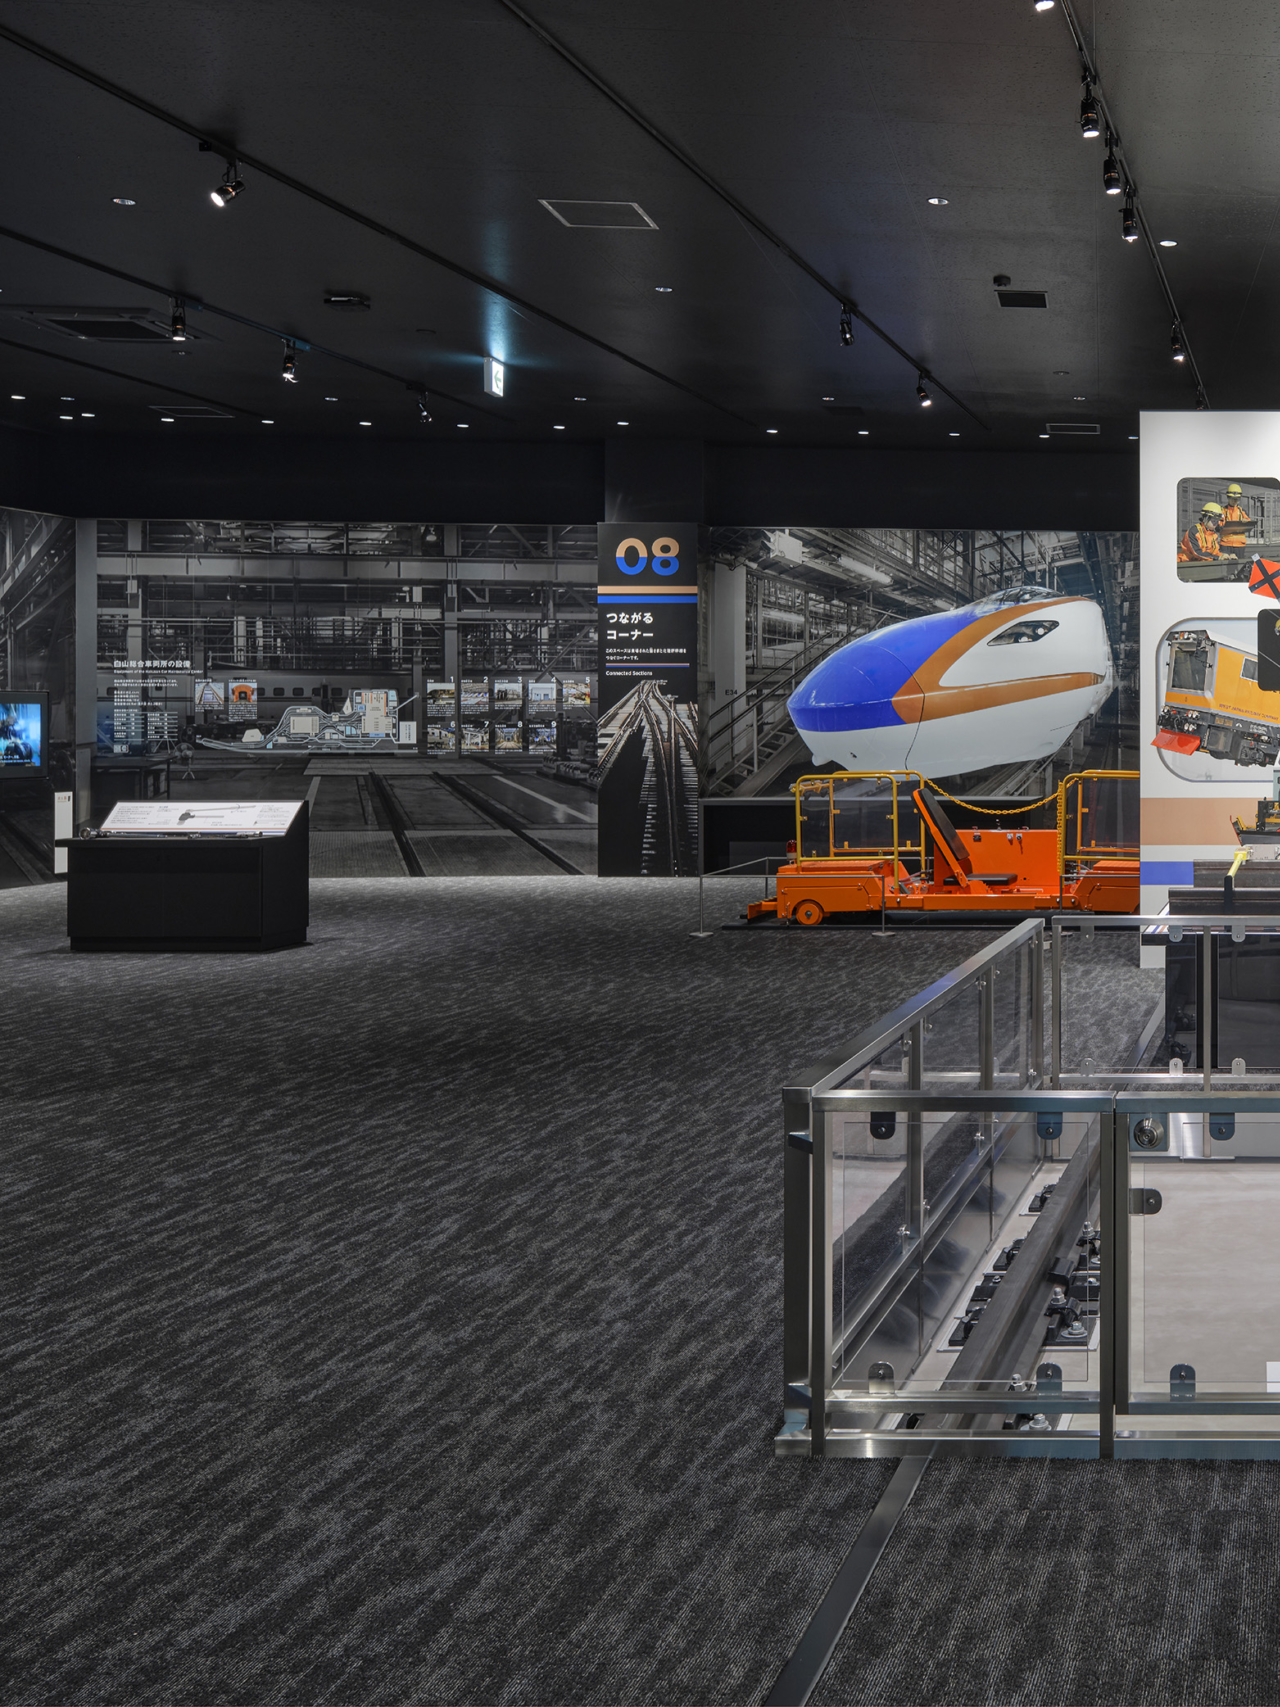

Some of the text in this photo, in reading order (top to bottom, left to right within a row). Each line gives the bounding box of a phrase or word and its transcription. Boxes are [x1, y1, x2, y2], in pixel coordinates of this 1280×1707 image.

[615, 537, 680, 576] 08
[606, 612, 654, 624] つながる
[606, 629, 654, 641] コーナー
